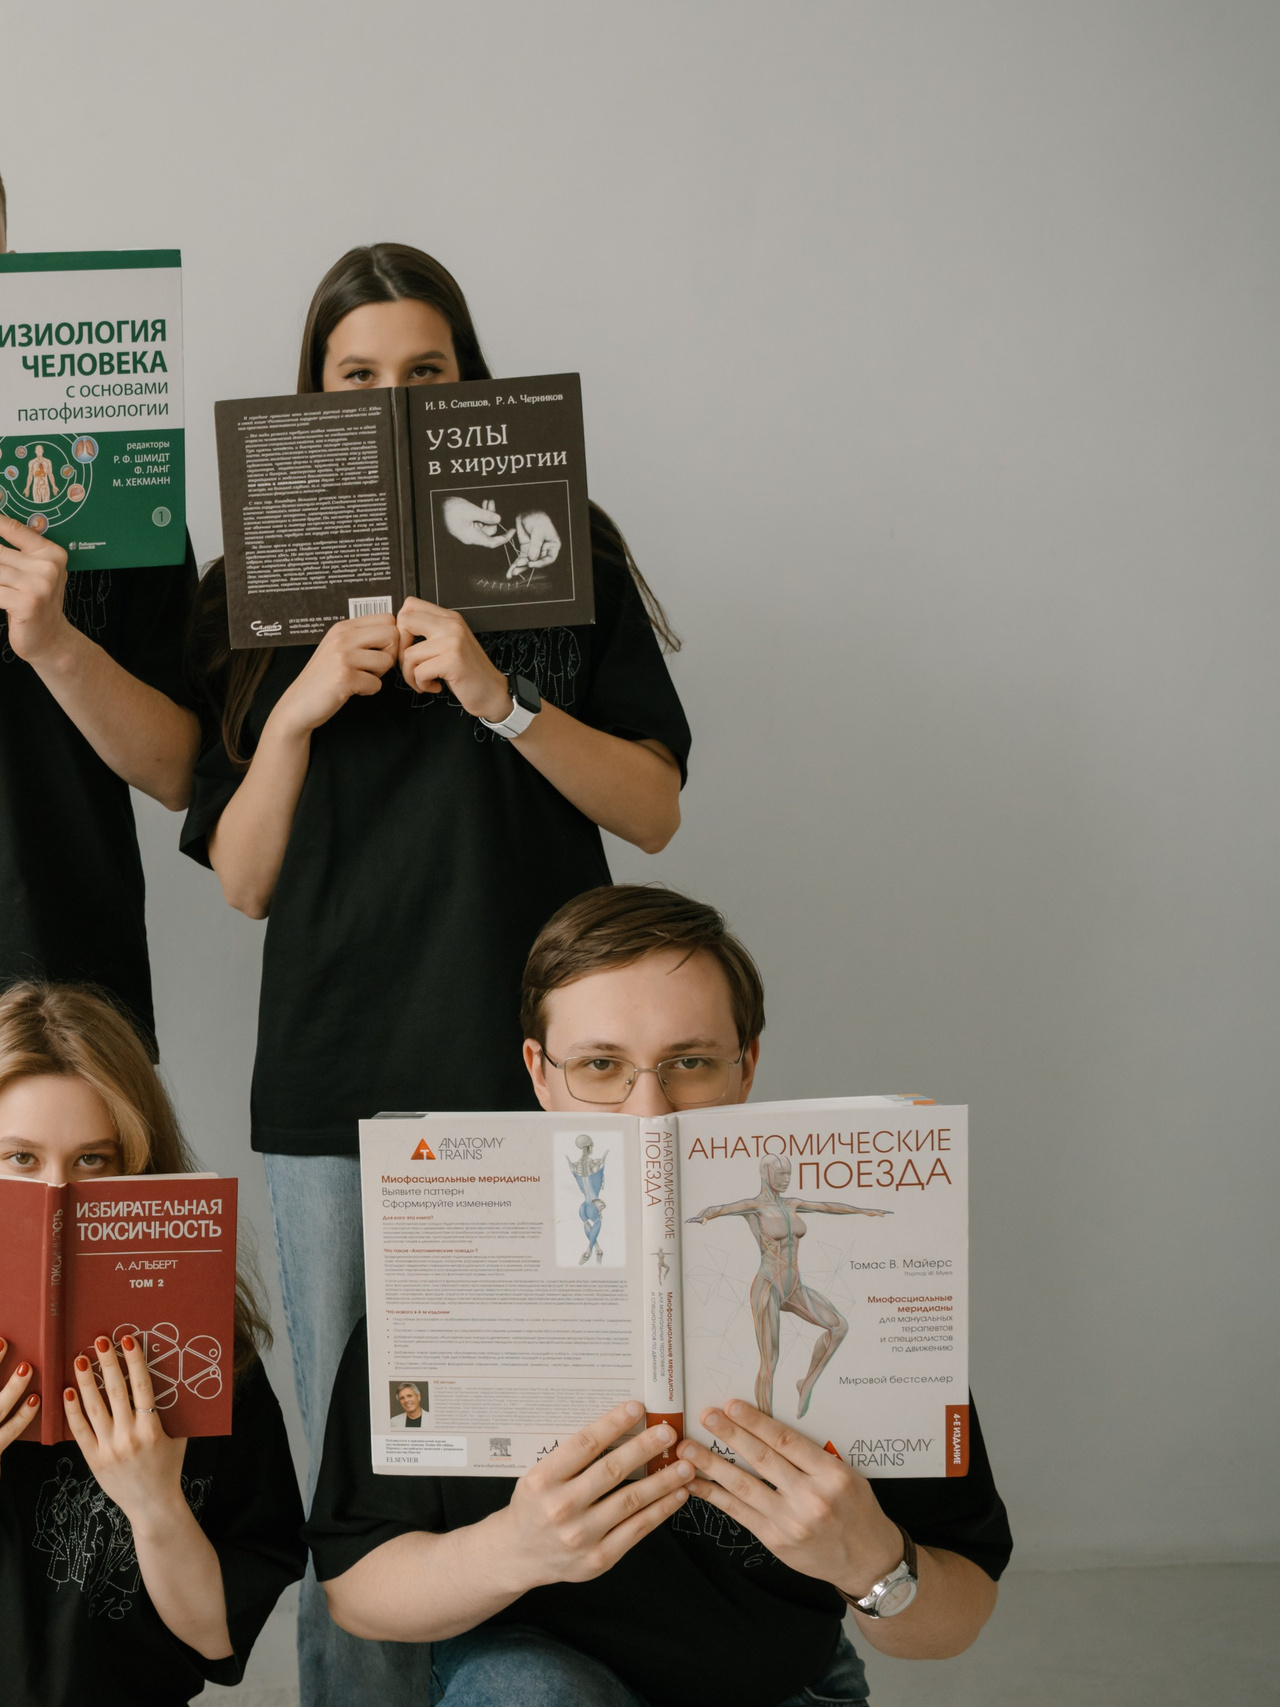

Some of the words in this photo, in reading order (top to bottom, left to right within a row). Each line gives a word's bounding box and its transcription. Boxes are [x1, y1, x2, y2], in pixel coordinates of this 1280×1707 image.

[22, 351, 168, 378] ЧЕЛОВЕКА
[66, 385, 75, 398] с
[80, 382, 168, 397] основами
[425, 402, 436, 410] И.
[439, 401, 448, 409] В.
[451, 399, 491, 408] Слепцов,
[496, 396, 505, 405] Р.
[507, 396, 517, 404] А.
[520, 393, 563, 404] Черников
[18, 402, 168, 424] патофизиологии
[426, 424, 508, 450] УЗЛЫ
[127, 441, 170, 450] редакторы
[114, 455, 121, 464] Р.
[122, 454, 132, 463] Ф.
[134, 453, 170, 462] ШМИДТ
[428, 461, 441, 475] в
[451, 451, 567, 475] хирургии
[134, 466, 144, 474] Ф.
[146, 465, 170, 474] ЛАНГ
[112, 478, 124, 487] М.
[126, 476, 170, 487] ХЕКМАНН
[158, 512, 163, 522] 1
[439, 1137, 504, 1149] ANATOMY
[688, 1128, 951, 1160] АНАТОМИЧЕСКИЕ
[438, 1149, 483, 1160] TRAINS
[644, 1131, 662, 1207] ПОЕЗДА
[799, 1158, 952, 1191] ПОЕЗДА
[381, 1175, 476, 1185] Миофасциальные
[478, 1175, 540, 1184] меридианы
[663, 1131, 675, 1239] АНАТОМИЧЕСКИЕ
[382, 1188, 421, 1196] Выявите
[424, 1189, 464, 1198] паттерн
[76, 1199, 222, 1218] ИЗБИРАТЕЛЬНАЯ
[383, 1199, 454, 1210] Сформируйте
[456, 1200, 512, 1208] изменения
[77, 1220, 222, 1241] ТОКСИЧНОСТЬ
[850, 1260, 886, 1270] Томас
[889, 1260, 899, 1269] В.
[902, 1258, 953, 1270] Майерс
[129, 1280, 153, 1288] ТОМ
[158, 1279, 164, 1287] 2
[867, 1294, 953, 1304] Миофасциальные
[897, 1304, 953, 1313] меридианы
[879, 1316, 895, 1324] для
[897, 1315, 953, 1323] мануальных
[901, 1324, 953, 1333] терапевтов
[887, 1334, 953, 1344] специалистов
[905, 1344, 953, 1352] движению
[839, 1375, 887, 1386] Мировой
[890, 1375, 953, 1384] бестселлер
[953, 1413, 961, 1426] 4-Е
[848, 1439, 932, 1453] ANATOMY
[953, 1428, 961, 1465] ИЗДАНИЕ
[848, 1453, 905, 1466] TRAINS
